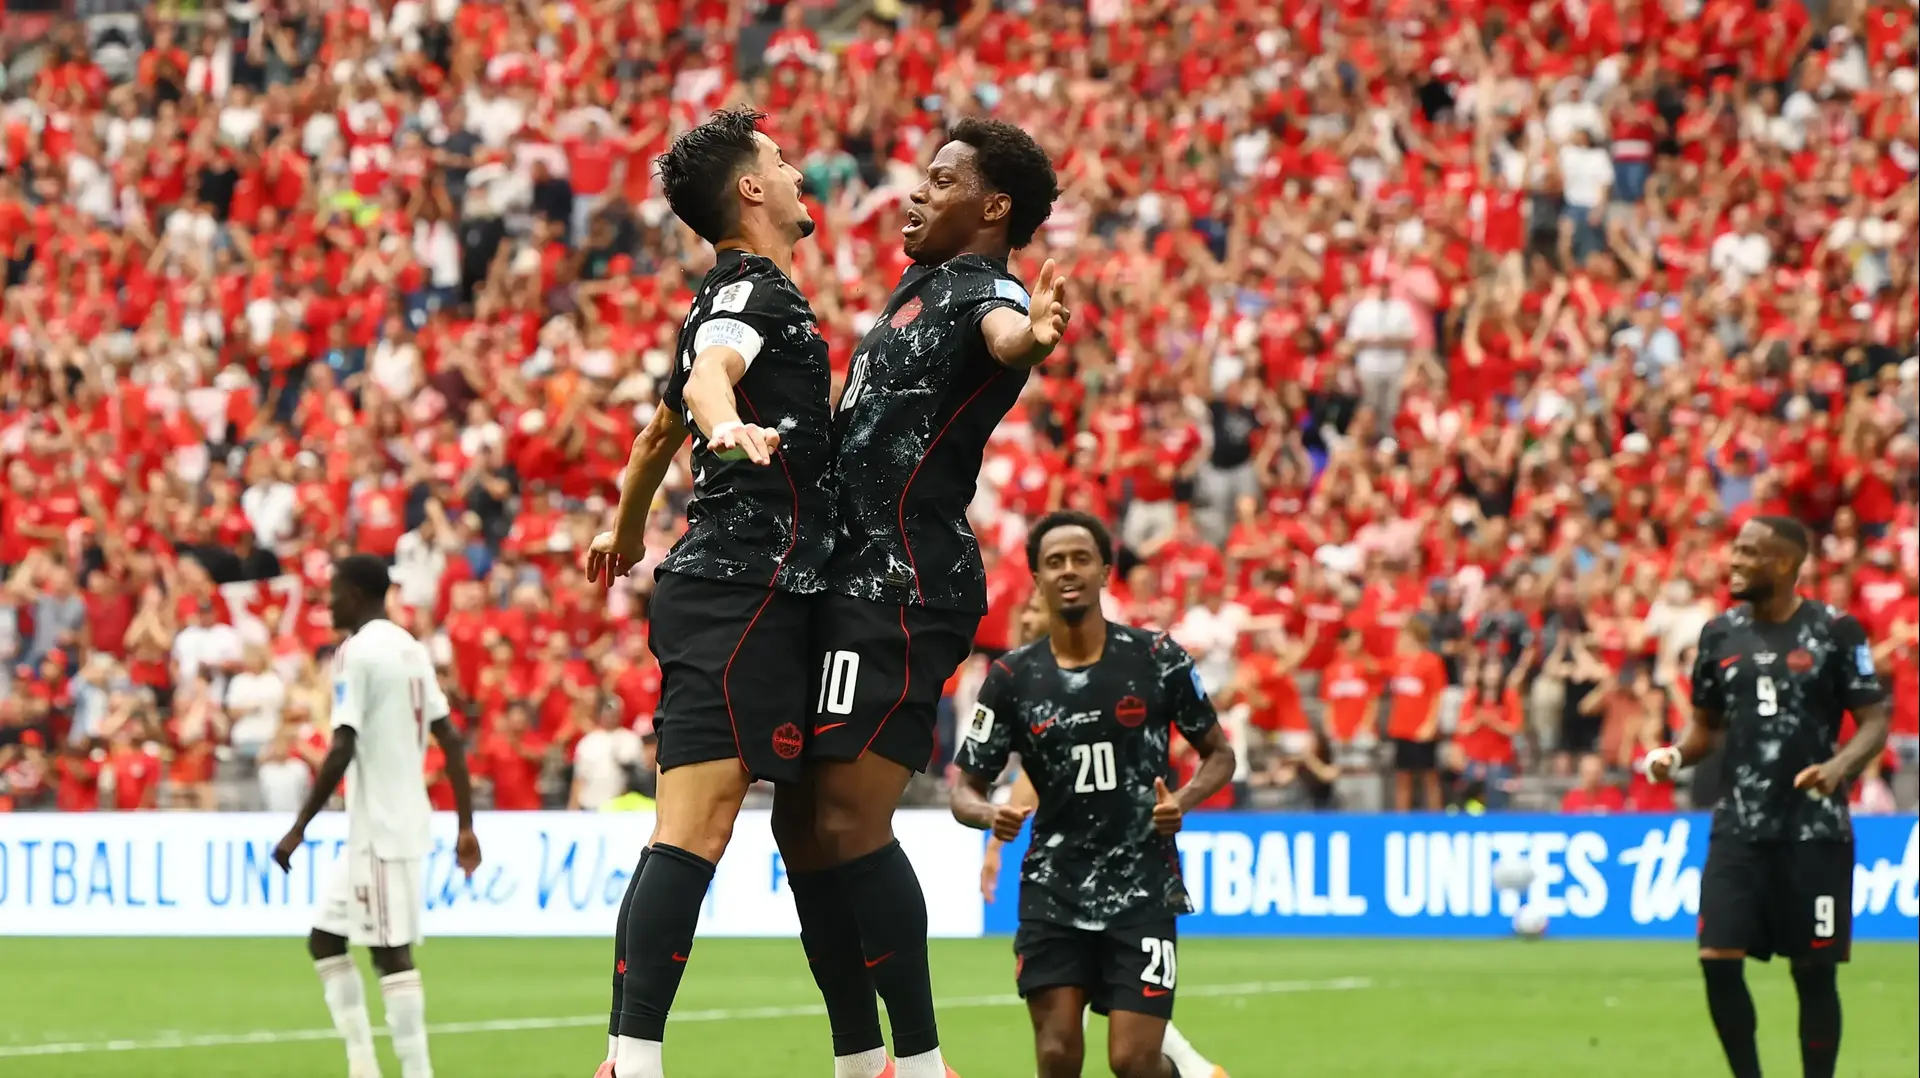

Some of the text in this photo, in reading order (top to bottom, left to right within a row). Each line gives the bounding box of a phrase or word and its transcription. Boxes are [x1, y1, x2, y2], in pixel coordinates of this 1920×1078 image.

[706, 325, 744, 338] UNITES
[817, 650, 860, 715] 10
[1756, 675, 1778, 716] 9
[1071, 741, 1117, 793] 20
[1176, 830, 1368, 916] TBALL
[1617, 818, 1701, 924] th
[1814, 895, 1835, 937] 9
[1140, 937, 1177, 990] 20
